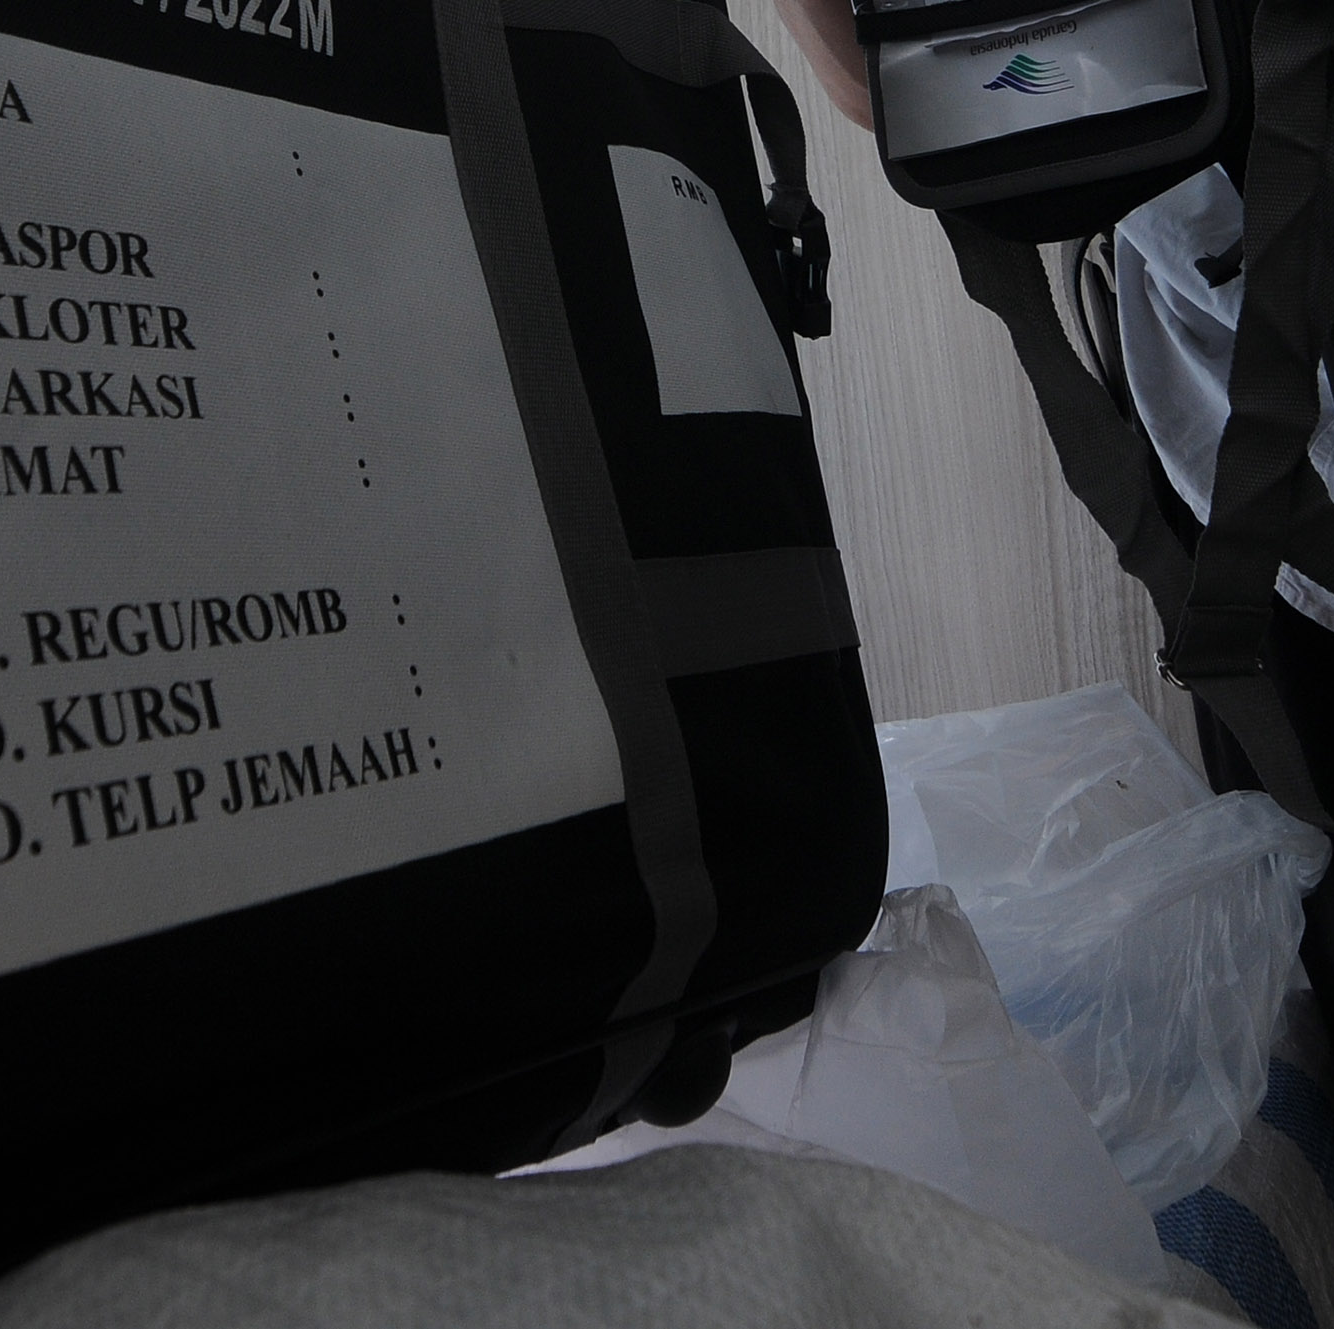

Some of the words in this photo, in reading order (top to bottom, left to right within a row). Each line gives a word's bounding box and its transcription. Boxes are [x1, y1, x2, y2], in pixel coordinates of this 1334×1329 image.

[970, 35, 1029, 56] Indonesia
[1032, 20, 1077, 41] Garuda
[671, 175, 707, 204] RMB
[21, 587, 347, 666] REGU/ROMB
[39, 678, 222, 757] KURSI
[53, 767, 207, 849] TELP
